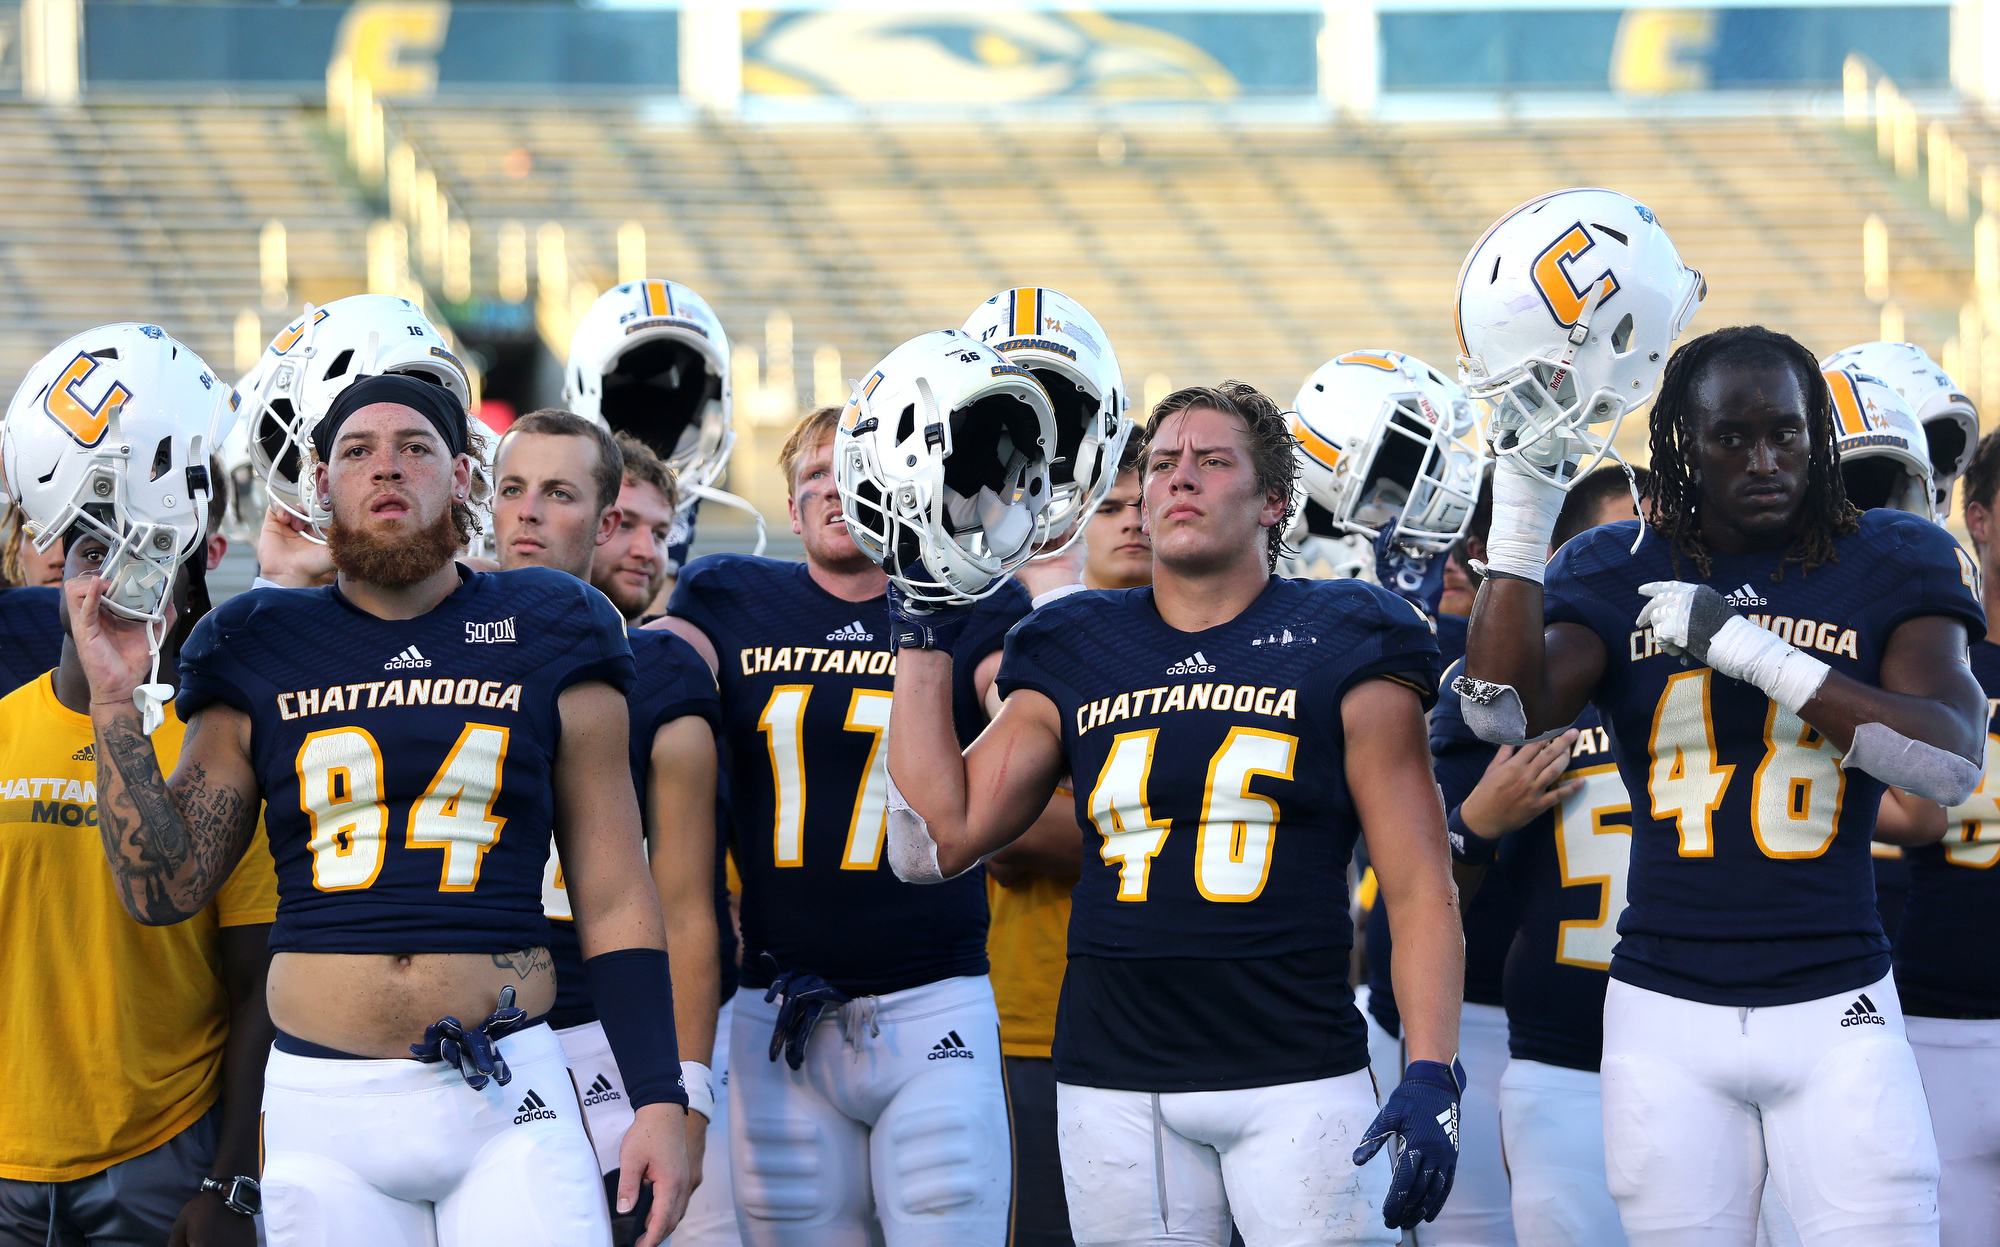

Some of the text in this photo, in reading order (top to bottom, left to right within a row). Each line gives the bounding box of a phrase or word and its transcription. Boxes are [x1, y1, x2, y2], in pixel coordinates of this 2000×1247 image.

[1530, 220, 1621, 330] C
[407, 325, 424, 336] 16
[981, 325, 998, 342] 17
[960, 351, 981, 363] 46
[994, 338, 1078, 362] ATTANOOGA
[1550, 359, 1571, 391] Riddel
[44, 350, 134, 449] C
[1419, 398, 1437, 425] ddell
[1954, 547, 1982, 603] 4
[1728, 596, 1767, 607] didas
[826, 632, 874, 642] adidas
[1629, 613, 1858, 662] CHNOOGA
[384, 658, 432, 670] adidas
[740, 646, 897, 676] CHATTANO
[1166, 664, 1216, 675] adidas
[277, 678, 523, 721] CHATTANOOGA
[1076, 683, 1297, 737] CHATTANOOGA
[72, 752, 97, 762] adid
[1648, 667, 1847, 860] 48
[0, 777, 97, 803] HATTAN
[757, 684, 894, 871] 17
[31, 800, 98, 827] MOC
[295, 722, 511, 893] 84
[1087, 726, 1300, 903] 46
[1840, 1013, 1886, 1027] adidas
[927, 1047, 975, 1061] adidas
[584, 1088, 621, 1107] adidas
[513, 1108, 557, 1126] adidas
[1450, 1102, 1459, 1152] adidas
